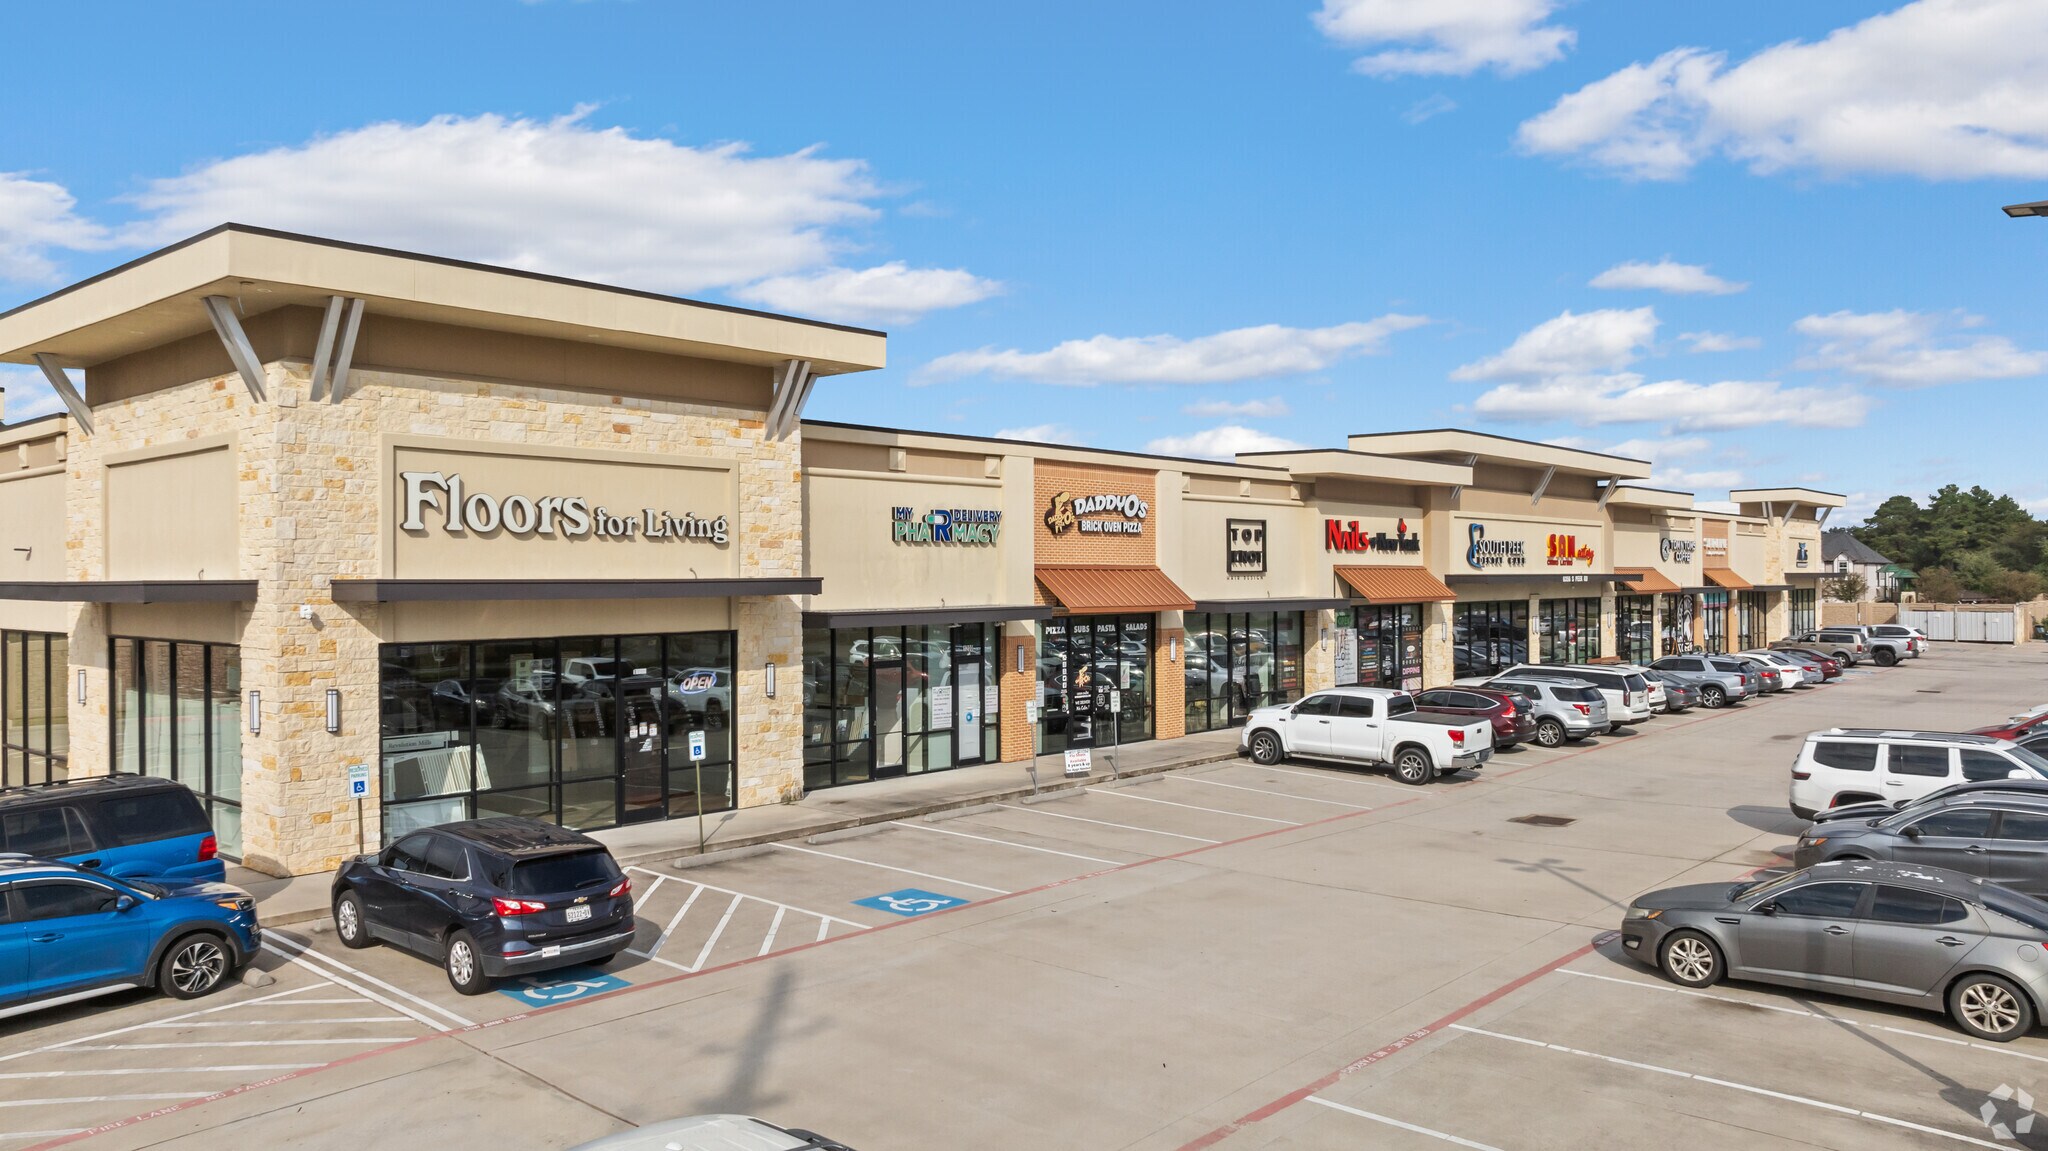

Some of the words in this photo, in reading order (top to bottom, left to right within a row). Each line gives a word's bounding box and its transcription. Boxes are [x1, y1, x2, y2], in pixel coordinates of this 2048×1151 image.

[401, 471, 590, 536] Floors
[595, 506, 638, 537] for
[643, 508, 729, 544] Living
[893, 507, 913, 520] MY
[953, 509, 1002, 522] DELIVERY
[894, 510, 1000, 543] PHARMACY
[1081, 520, 1102, 532] BRICK
[1104, 521, 1121, 533] OVEN
[1123, 522, 1142, 533] PIZZA
[1230, 528, 1263, 541] TOP
[1326, 519, 1369, 551] Nails
[1478, 540, 1505, 554] SOUTH
[1509, 541, 1525, 554] PEEK
[1402, 667, 1420, 675] DIPPING
[683, 676, 713, 690] OPEN
[88, 1119, 129, 1135] FIRE
[136, 1104, 183, 1121] LANE
[205, 1092, 227, 1102] NO
[233, 1072, 297, 1093] PARKING
